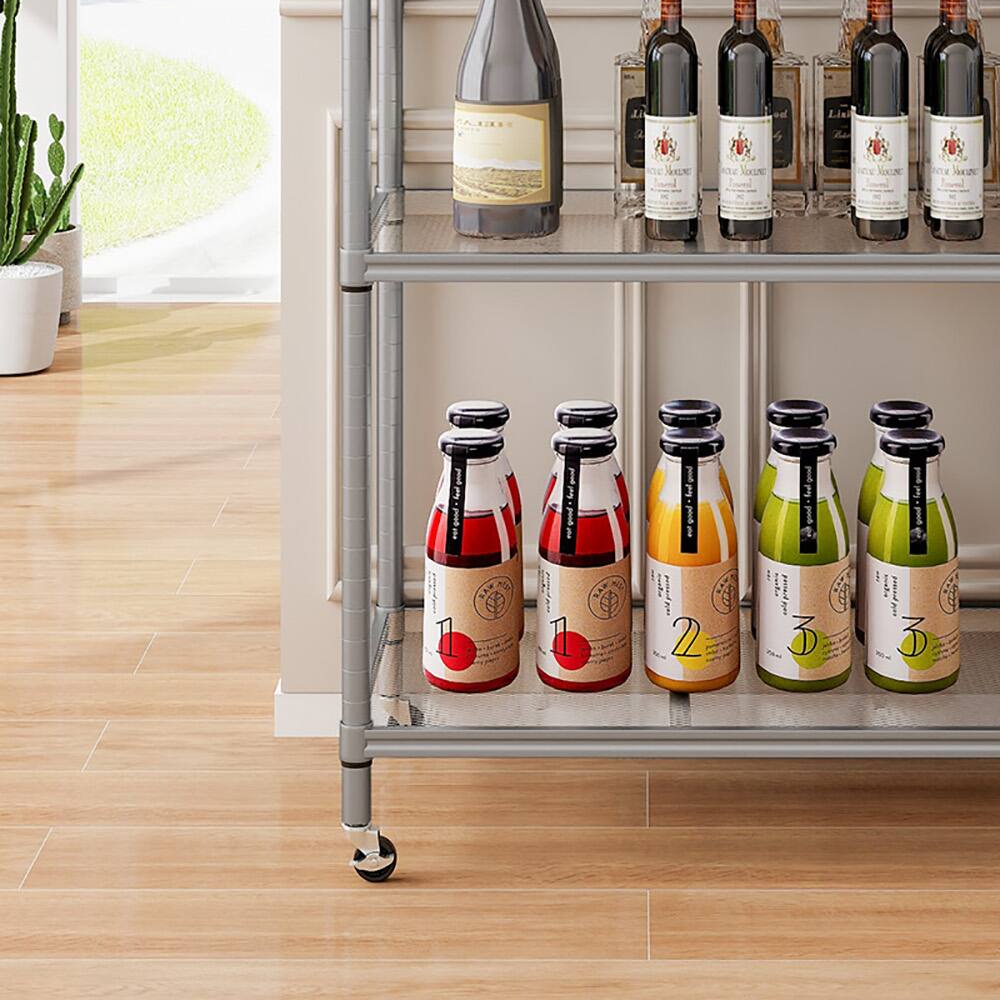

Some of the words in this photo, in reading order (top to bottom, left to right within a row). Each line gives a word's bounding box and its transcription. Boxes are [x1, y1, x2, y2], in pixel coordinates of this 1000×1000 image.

[568, 467, 576, 485] good
[685, 466, 694, 483] good
[804, 465, 813, 483] good
[913, 466, 923, 484] good
[566, 486, 575, 499] feel
[685, 484, 693, 497] feel
[803, 484, 812, 497] feel
[912, 485, 921, 498] feel
[452, 508, 460, 527] good
[566, 507, 574, 526] good
[685, 505, 694, 524] good
[803, 505, 813, 524] good
[913, 506, 923, 526] good
[436, 617, 458, 658] 1
[550, 616, 573, 657] 1
[671, 616, 702, 657] 2
[787, 615, 817, 656] 3
[896, 616, 927, 657] 3
